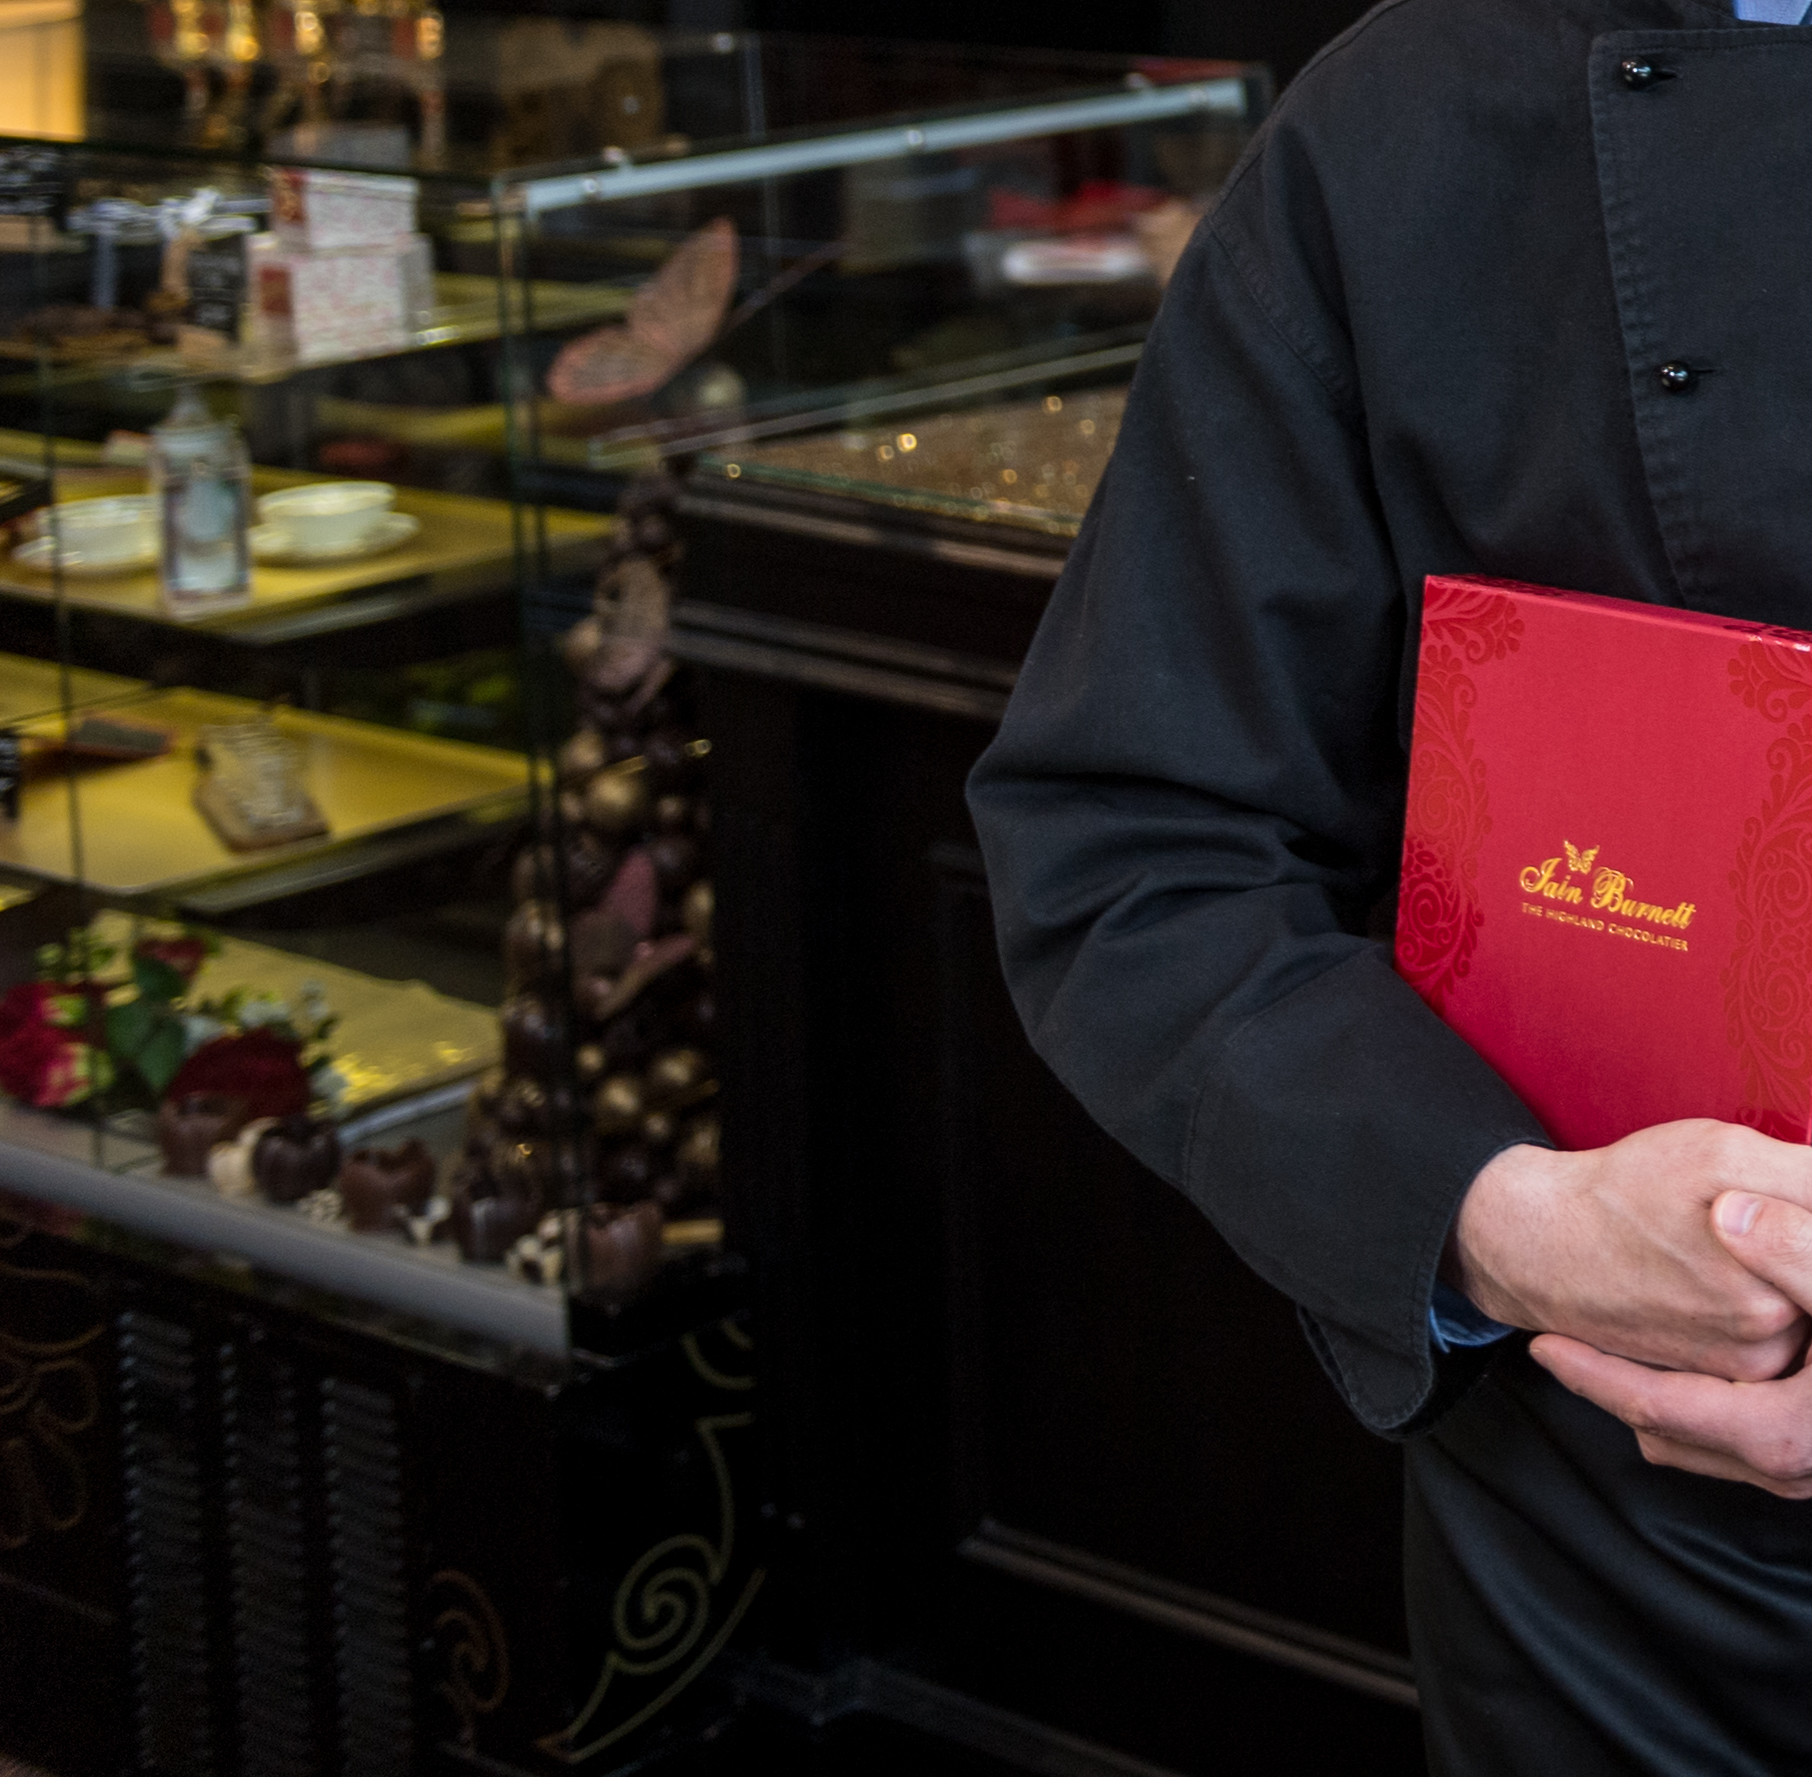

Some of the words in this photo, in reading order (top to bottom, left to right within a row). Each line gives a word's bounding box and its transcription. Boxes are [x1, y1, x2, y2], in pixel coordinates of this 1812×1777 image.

[1519, 858, 1583, 904] Iain
[1590, 866, 1696, 929] Burnett
[1522, 902, 1543, 917] THE
[1546, 909, 1605, 931] HIGHLAND
[1608, 923, 1688, 951] CHOCOLATIER
